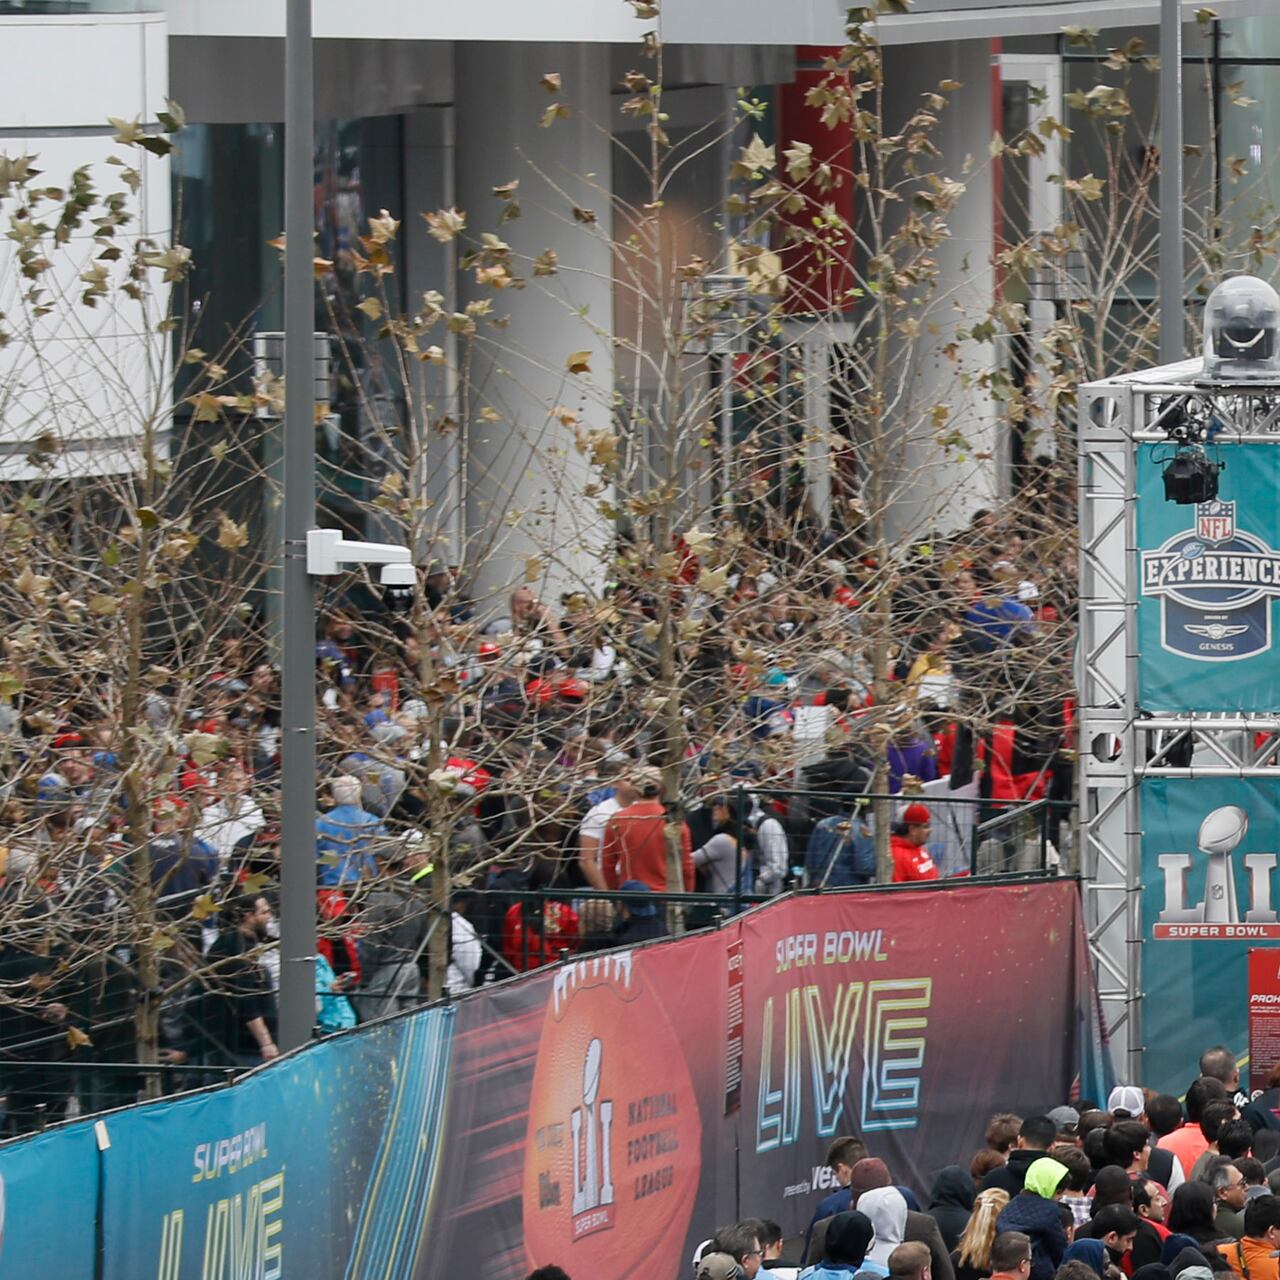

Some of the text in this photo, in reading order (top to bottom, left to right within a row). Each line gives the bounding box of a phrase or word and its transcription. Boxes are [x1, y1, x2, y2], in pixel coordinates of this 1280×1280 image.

[1199, 517, 1232, 538] NFL
[1198, 642, 1235, 651] GENESIS
[1168, 926, 1268, 937] SUPER BOWL
[776, 929, 888, 973] SUPER BOWL
[755, 976, 932, 1153] LIVE
